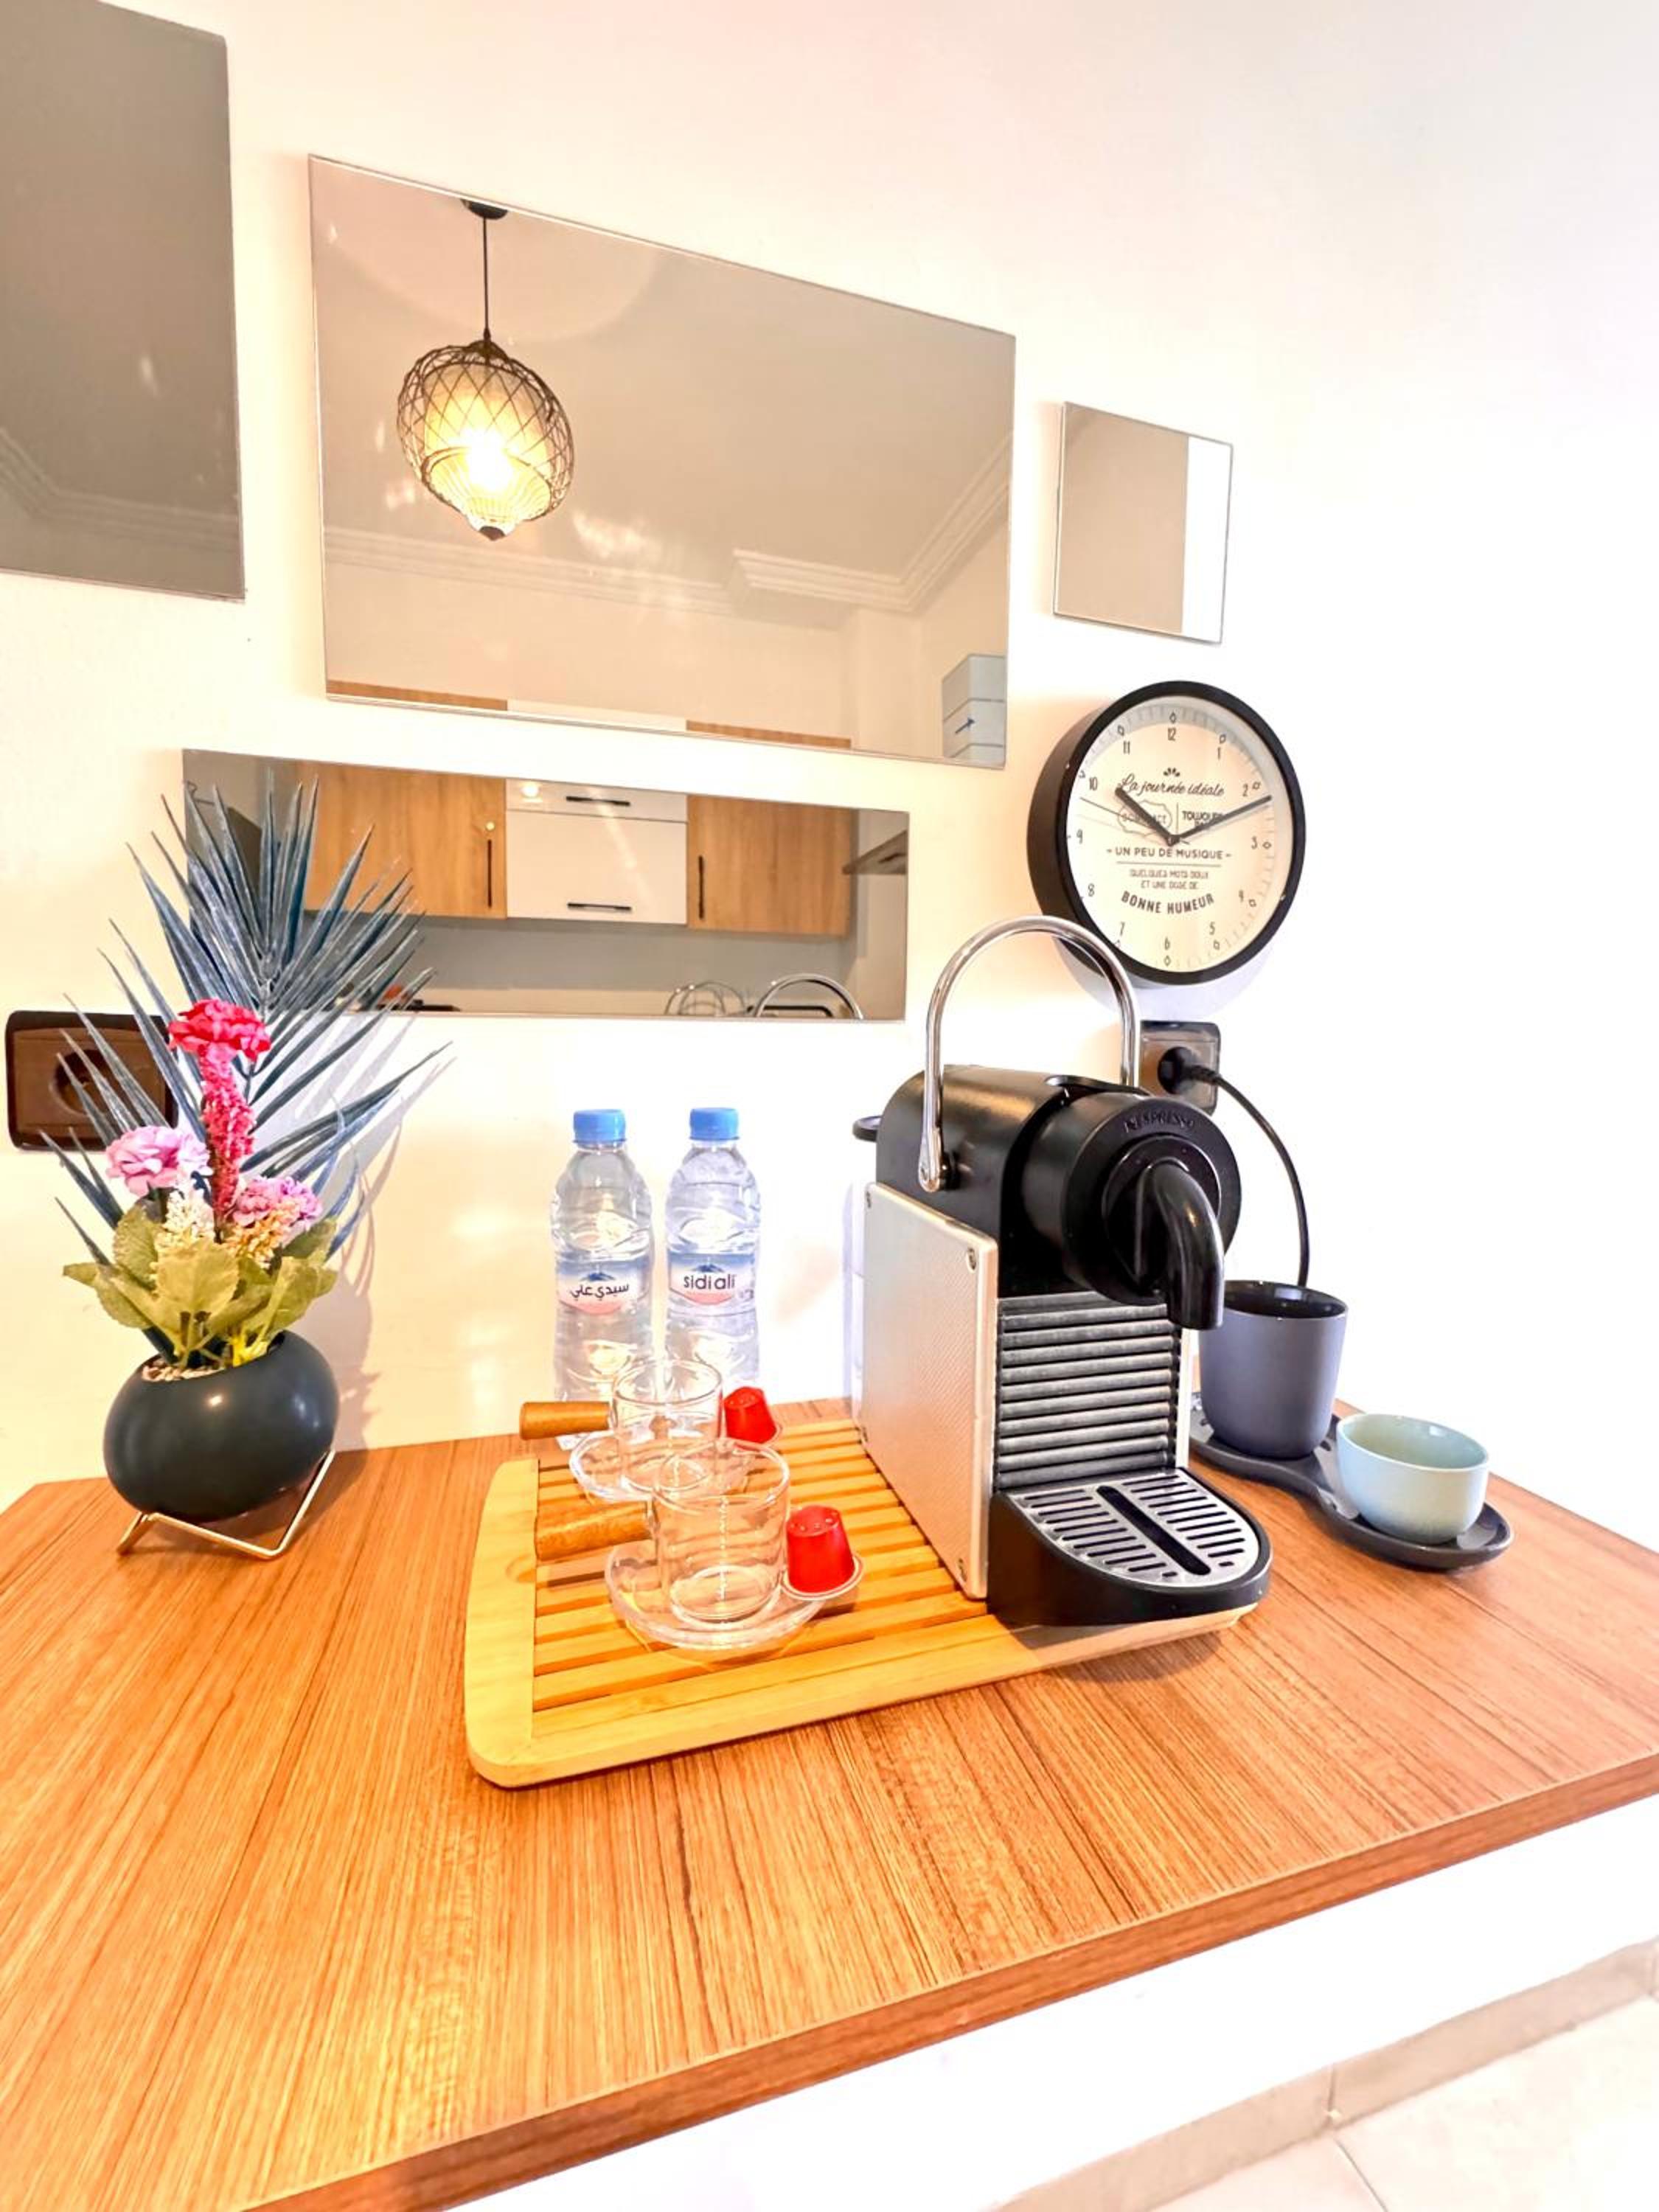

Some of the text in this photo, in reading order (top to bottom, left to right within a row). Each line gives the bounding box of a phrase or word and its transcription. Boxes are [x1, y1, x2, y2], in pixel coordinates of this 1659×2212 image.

[1167, 728, 1176, 741] 12
[1123, 740, 1130, 755] 11
[1217, 747, 1221, 760] 1
[1089, 776, 1098, 790] 10
[1119, 773, 1225, 796] La journée idéale
[1242, 784, 1248, 797] 2
[1077, 829, 1083, 844] 9
[1251, 837, 1257, 849] 3
[1115, 846, 1223, 859] UN PEU DE MUSIQUE
[1088, 883, 1095, 897] 8
[1121, 890, 1214, 914] BONNE HUMEUR
[1120, 922, 1125, 936] 7
[1209, 922, 1215, 935] 5
[1165, 938, 1170, 950] 6
[570, 1284, 629, 1301] سيدي علي
